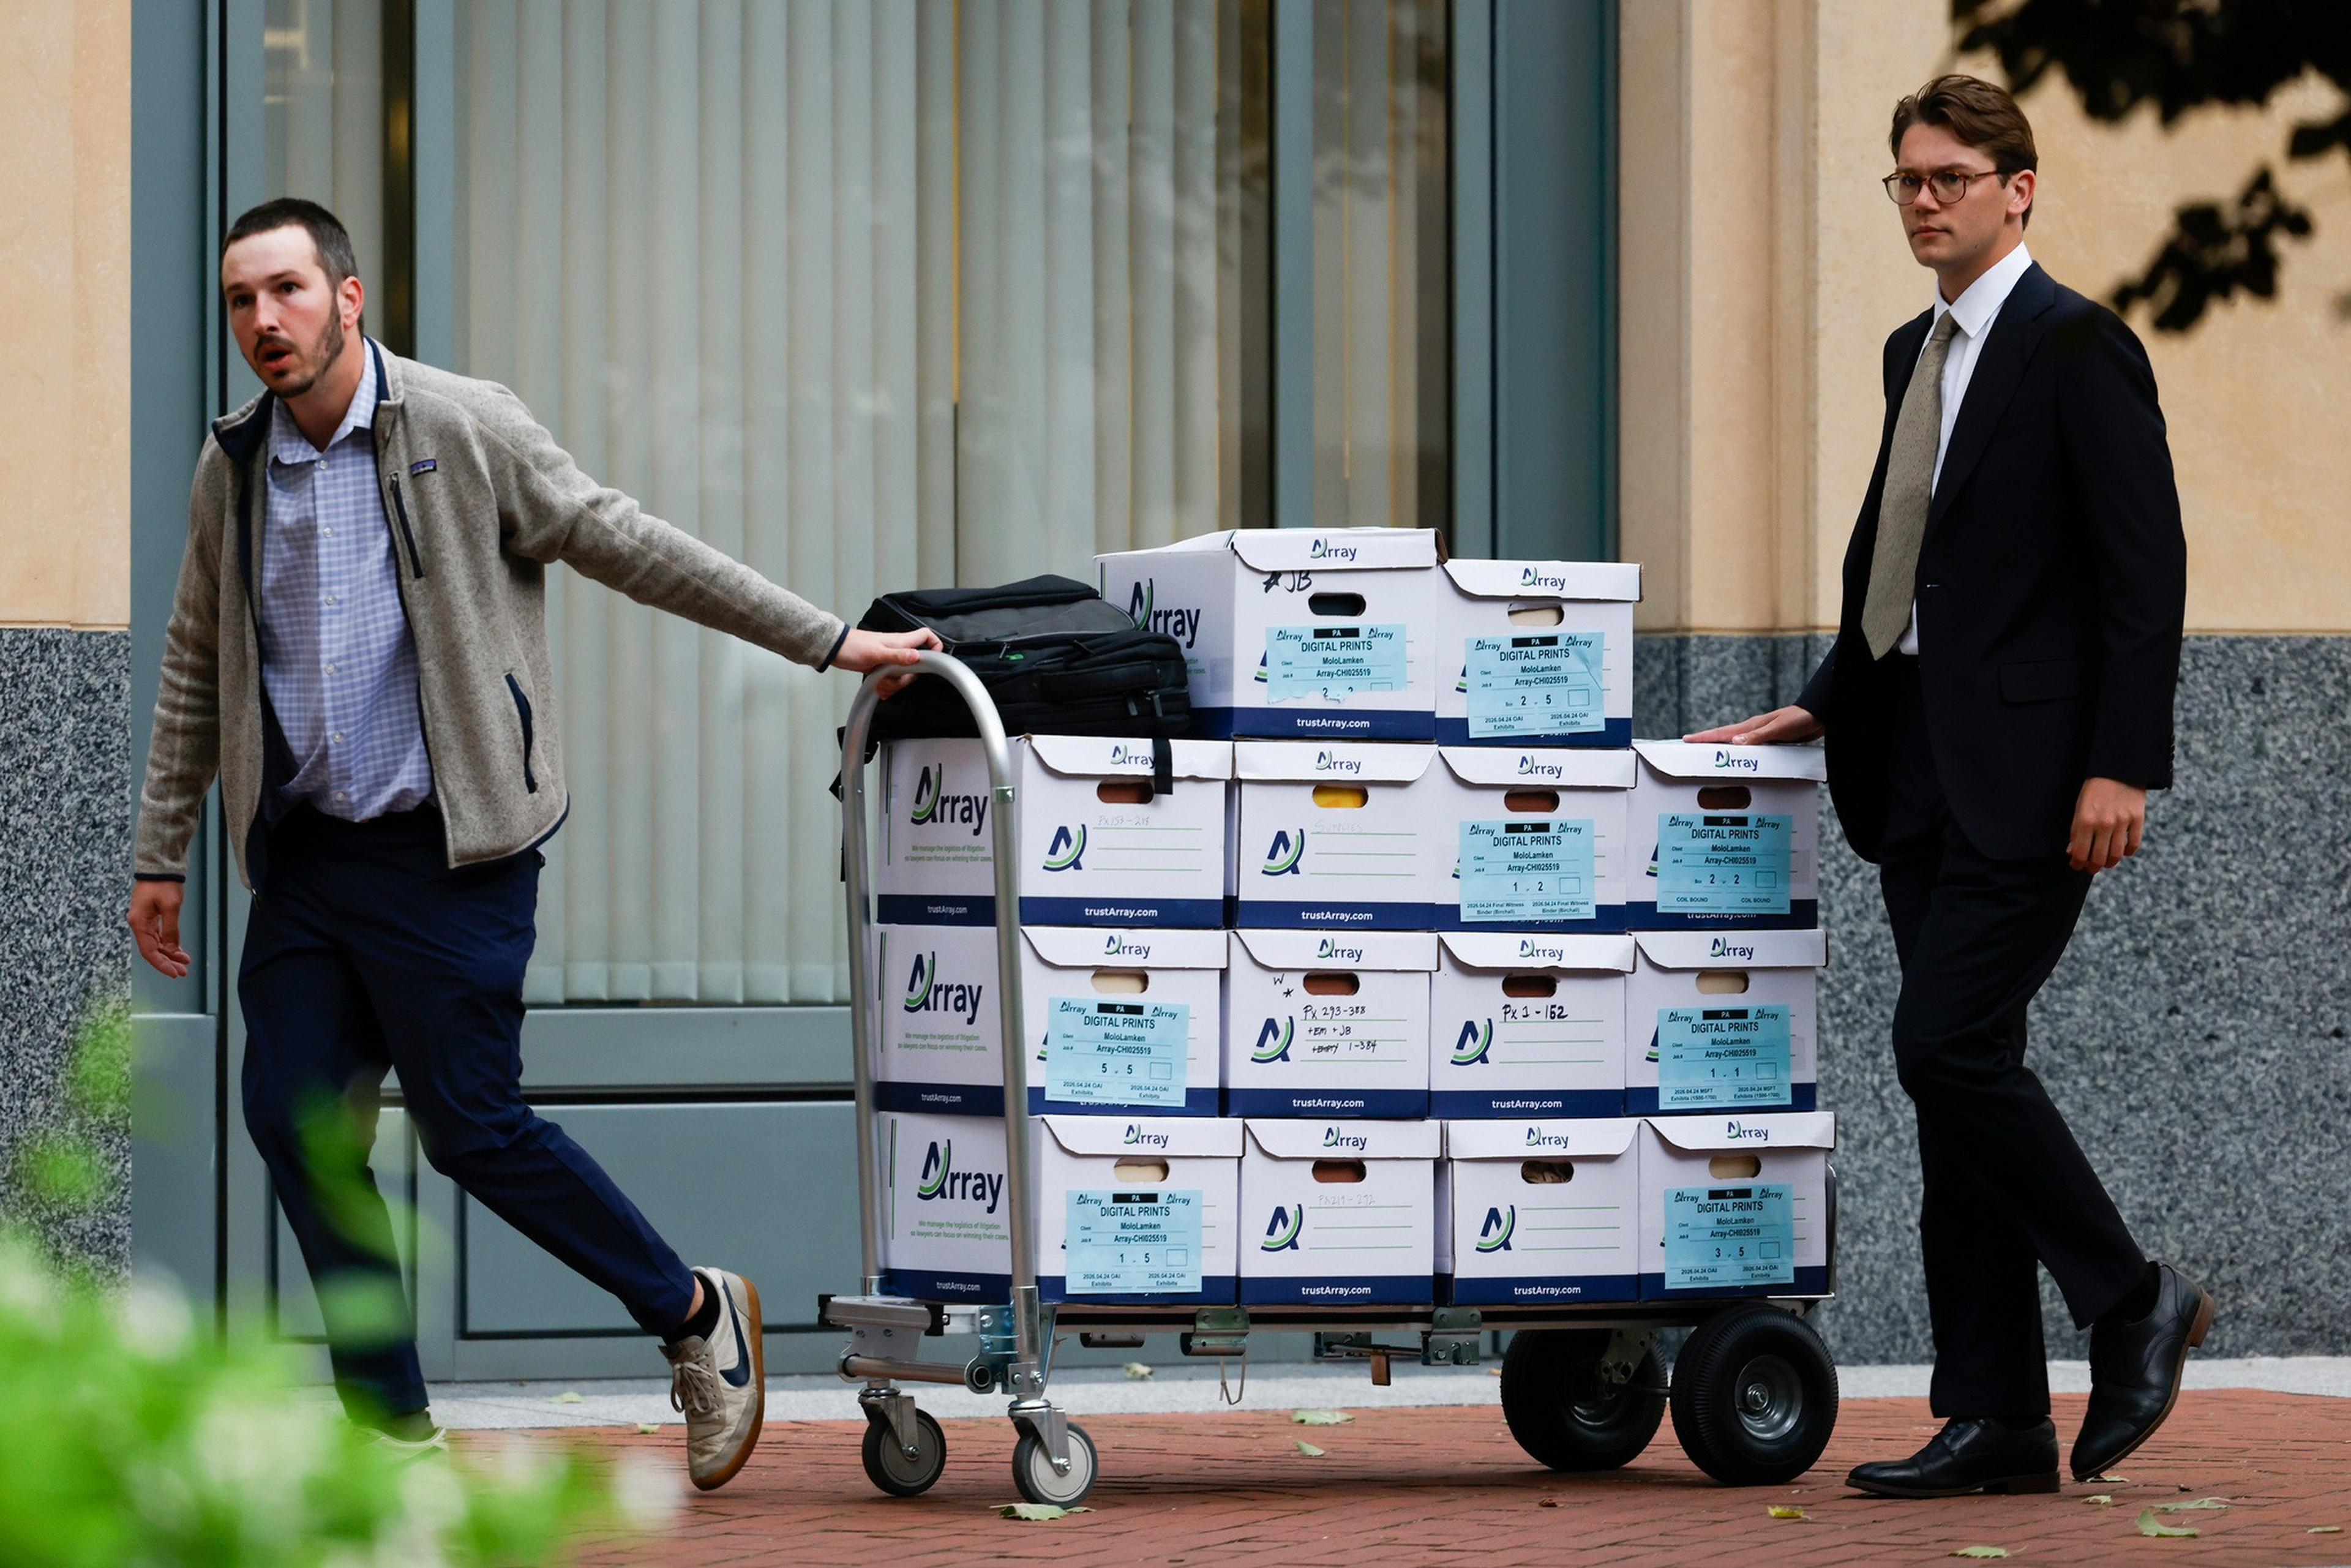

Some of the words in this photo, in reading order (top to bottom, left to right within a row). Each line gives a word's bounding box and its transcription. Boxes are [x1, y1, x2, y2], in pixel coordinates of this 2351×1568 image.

[1310, 538, 1357, 561] Array
[1521, 567, 1565, 591] Array
[1130, 578, 1201, 648] Array
[1277, 630, 1303, 641] Array
[1368, 628, 1393, 639] Array
[1302, 642, 1337, 652] DIGITAL
[1340, 641, 1373, 651] PRINTS
[1475, 640, 1501, 651] Array
[1565, 636, 1592, 648] Array
[1500, 651, 1535, 661] DIGITAL
[1539, 649, 1570, 659] PRINTS
[1521, 696, 1526, 705] 2
[1546, 695, 1551, 704] 5
[1297, 718, 1370, 729] trustArray.com
[1111, 745, 1155, 768] Array
[1316, 751, 1361, 774] Array
[1715, 749, 1758, 771] Array
[1518, 756, 1562, 778] Array
[911, 763, 988, 836] Array
[1669, 816, 1693, 828] Array
[1755, 817, 1780, 830] Array
[1469, 825, 1494, 836] Array
[1558, 823, 1582, 835] Array
[1692, 830, 1726, 839] DIGITAL
[1729, 830, 1759, 839] PRINTS
[1493, 837, 1528, 846] DIGITAL
[1531, 836, 1561, 845] PRINTS
[1710, 874, 1715, 884] 2
[1734, 874, 1739, 884] 2
[1513, 882, 1517, 891] 1
[1538, 882, 1543, 891] 2
[928, 906, 967, 916] trustArray.com
[1085, 907, 1158, 918] trustArray.com
[1302, 911, 1373, 921] trustArray.com
[1104, 934, 1150, 959] Array
[1318, 938, 1362, 961] Array
[1519, 939, 1563, 961] Array
[1711, 937, 1753, 959] Array
[904, 951, 982, 1025] Array
[1060, 1001, 1086, 1015] Array
[1151, 1007, 1178, 1020] Array
[1668, 1011, 1693, 1024] Array
[1755, 1009, 1779, 1020] Array
[1084, 1016, 1119, 1027] DIGITAL
[1122, 1018, 1155, 1029] PRINTS
[1692, 1024, 1725, 1033] DIGITAL
[1728, 1022, 1758, 1031] PRINTS
[1104, 1033, 1146, 1041] MoloLamken
[1102, 1063, 1107, 1073] 5
[1128, 1065, 1133, 1074] 5
[1711, 1068, 1715, 1078] 1
[1735, 1067, 1739, 1076] 1
[921, 1093, 961, 1104] trustArray.com
[1292, 1098, 1364, 1108] trustArray.com
[1491, 1100, 1562, 1109] trustArray.com
[1124, 1124, 1168, 1148] Array
[1727, 1120, 1768, 1140] Array
[1323, 1127, 1367, 1150] Array
[1526, 1127, 1569, 1149] Array
[917, 1139, 1003, 1214] Array
[1674, 1191, 1699, 1203] Array
[1759, 1188, 1782, 1199] Array
[1077, 1194, 1102, 1206] Array
[1166, 1194, 1191, 1206] Array
[1101, 1207, 1135, 1216] DIGITAL
[1138, 1207, 1170, 1216] PRINTS
[1698, 1204, 1730, 1213] DIGITAL
[1733, 1201, 1763, 1211] PRINTS
[1120, 1254, 1123, 1263] 1
[1145, 1253, 1150, 1263] 5
[1715, 1248, 1720, 1258] 3
[1739, 1247, 1744, 1256] 5
[937, 1281, 980, 1291] trustArray.com
[1302, 1286, 1371, 1296] trustArray.com
[1514, 1286, 1581, 1296] trustArray.com
